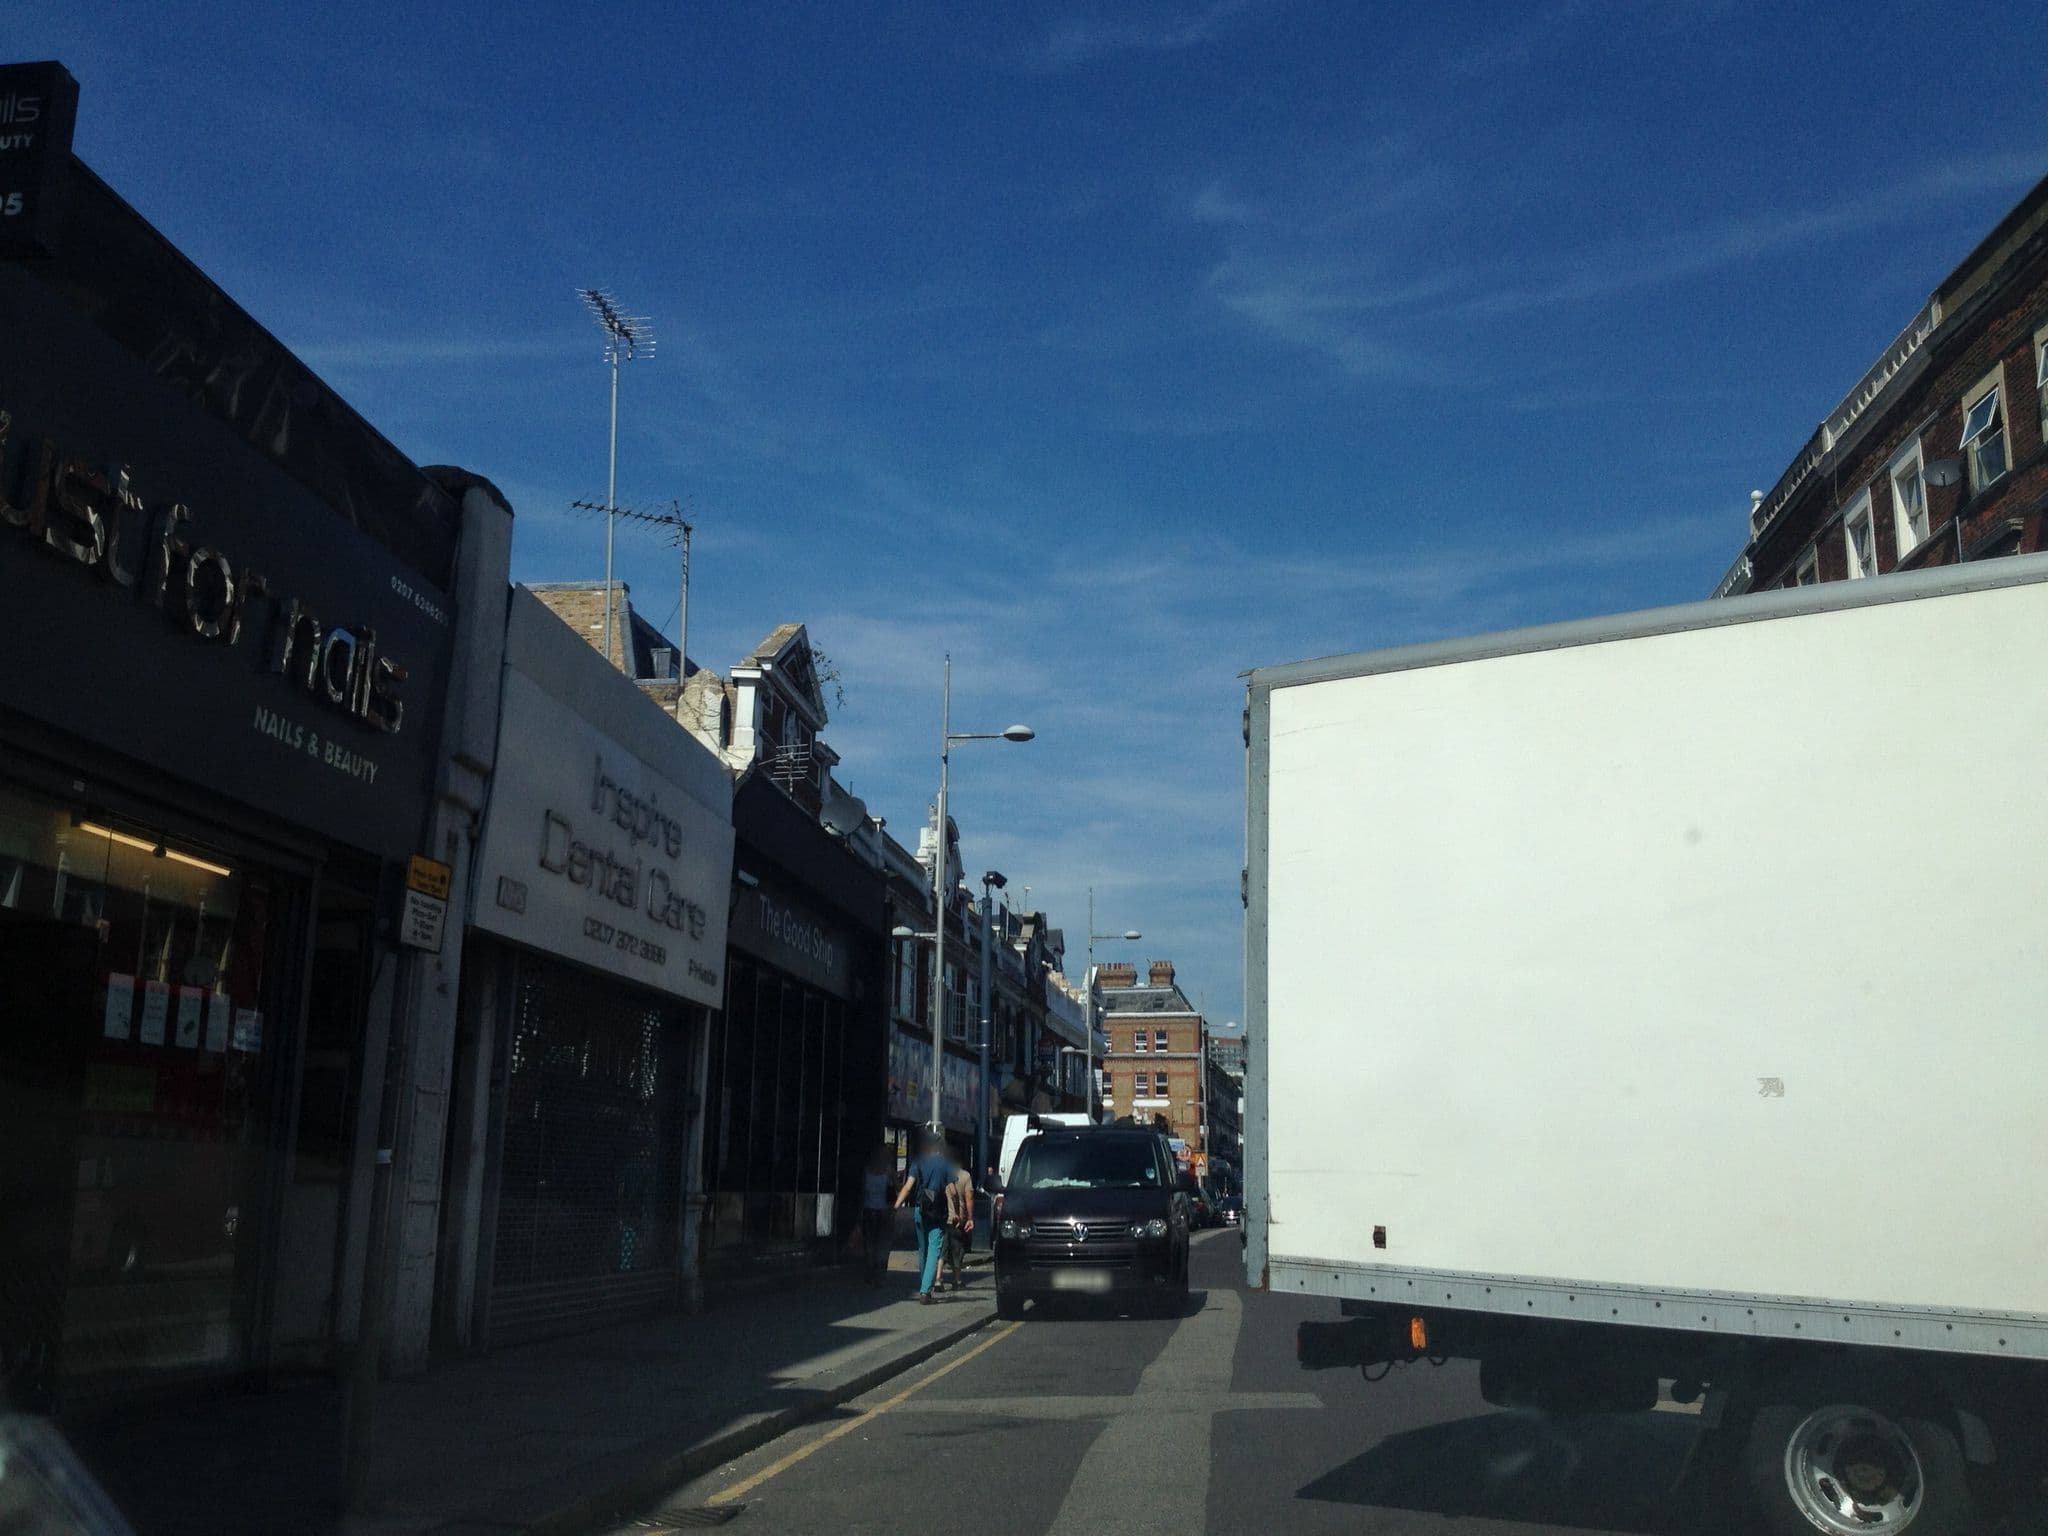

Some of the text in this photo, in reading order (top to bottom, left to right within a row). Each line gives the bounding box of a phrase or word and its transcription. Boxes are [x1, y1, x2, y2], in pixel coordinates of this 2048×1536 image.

[158, 502, 267, 647] for
[278, 598, 409, 735] nails
[253, 704, 380, 784] NAILS & BEAUTY
[591, 754, 682, 859] Inspire
[540, 808, 643, 912] Dental
[647, 868, 707, 942] Care
[760, 893, 833, 977] The Good Ship
